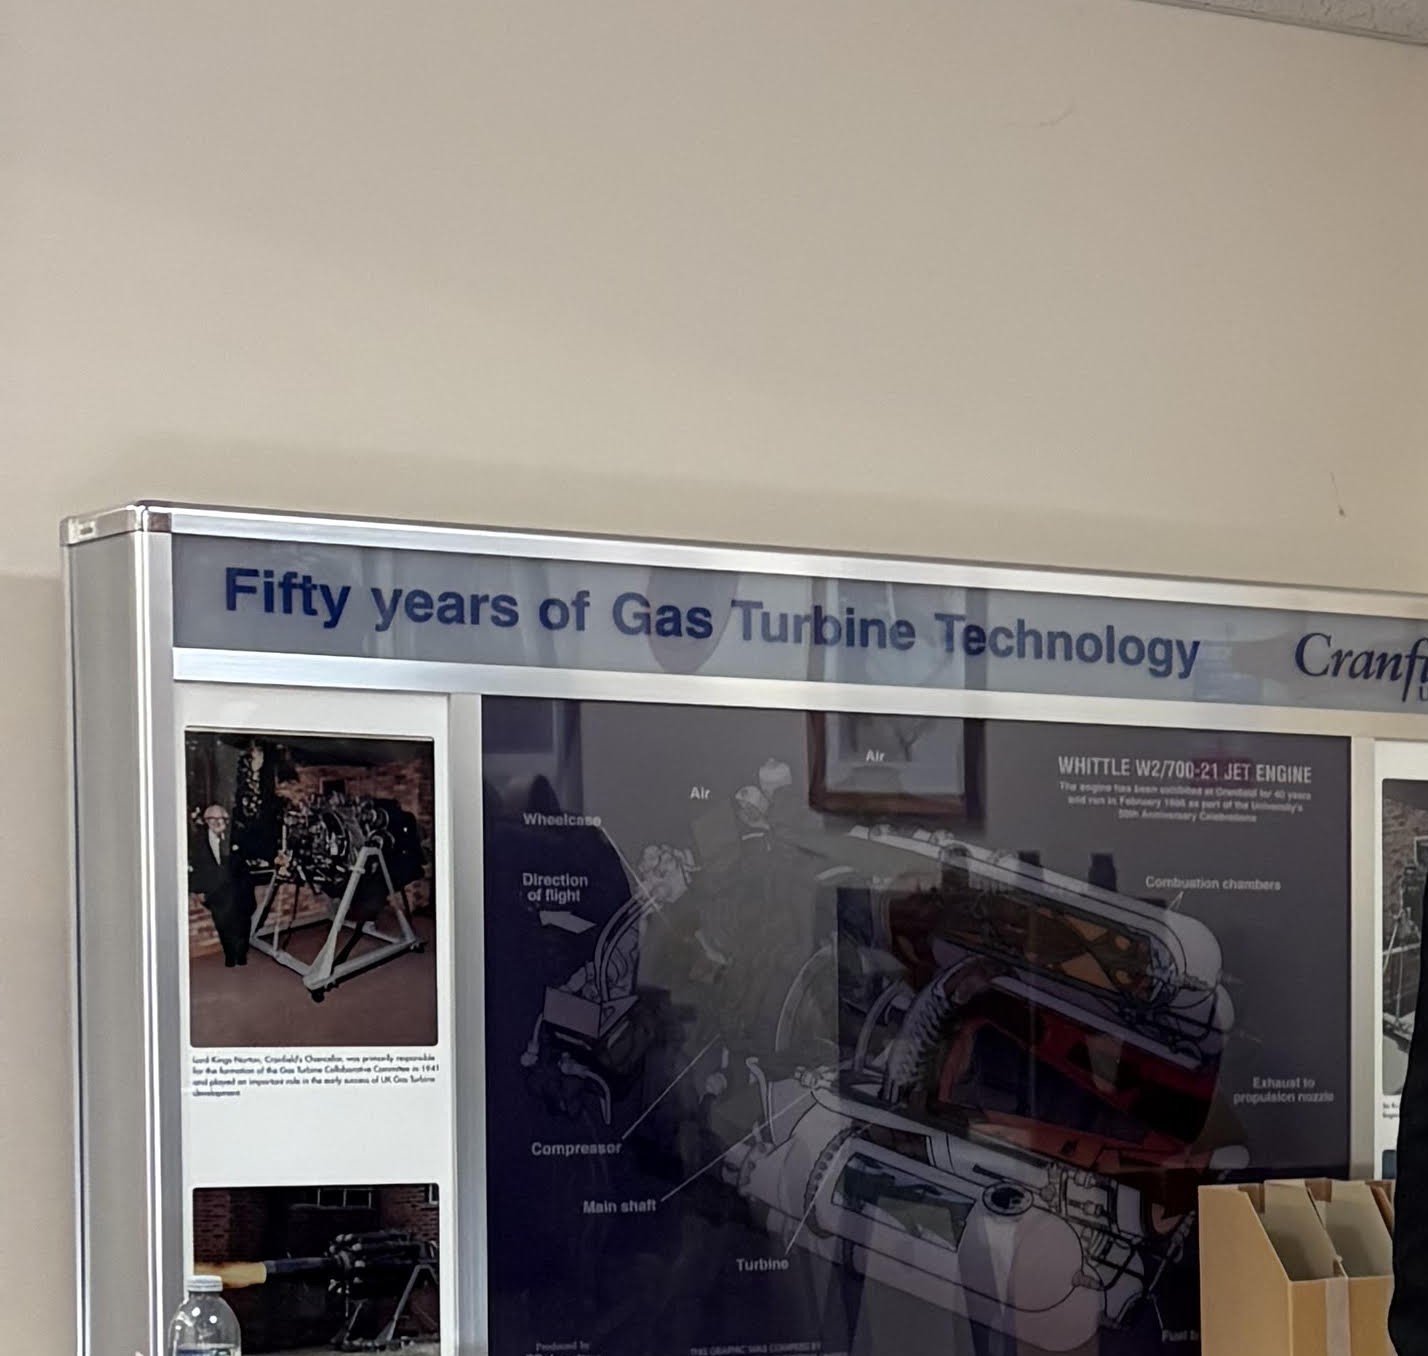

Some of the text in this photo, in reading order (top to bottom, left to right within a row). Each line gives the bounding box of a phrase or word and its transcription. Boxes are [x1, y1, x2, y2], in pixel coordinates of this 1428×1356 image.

[225, 567, 1200, 679] Fifty years of Gas Turbine Technology
[865, 749, 885, 763] Air
[1057, 755, 1312, 784] WHITTLE W2/700-21 JET ENGINE
[690, 787, 711, 800] Air
[523, 812, 602, 827] Wheelcase
[522, 872, 589, 887] Direction
[1145, 875, 1281, 892] Combustion chambers
[527, 888, 581, 905] of flight
[1252, 1076, 1316, 1089] Exhaust to
[530, 1141, 622, 1158] Compressor
[583, 1198, 658, 1213] Main shaft
[736, 1256, 790, 1271] Turbine
